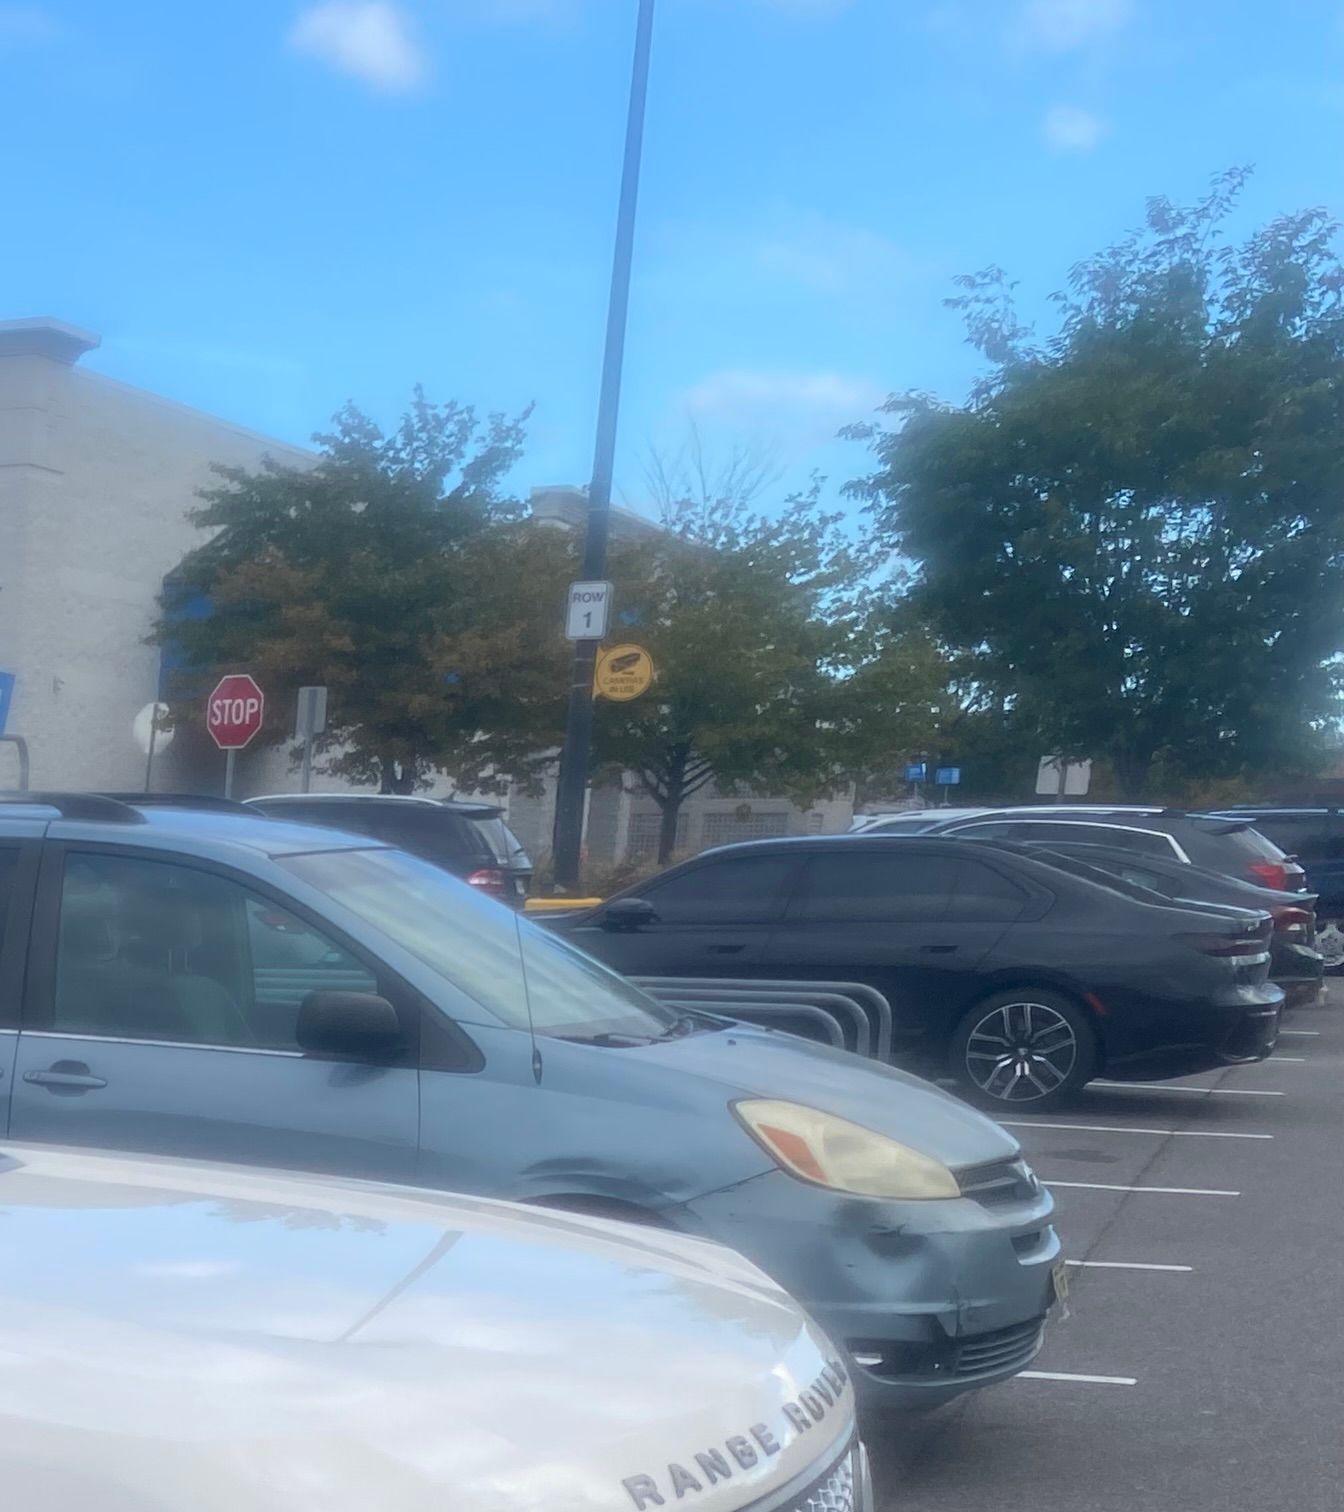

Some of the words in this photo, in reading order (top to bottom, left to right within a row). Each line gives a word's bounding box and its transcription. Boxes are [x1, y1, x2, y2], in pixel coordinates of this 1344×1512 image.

[573, 592, 604, 603] ROW
[583, 611, 592, 628] 1
[212, 698, 258, 725] STOP
[622, 1423, 780, 1511] RANGE
[782, 1360, 848, 1434] ROVER
